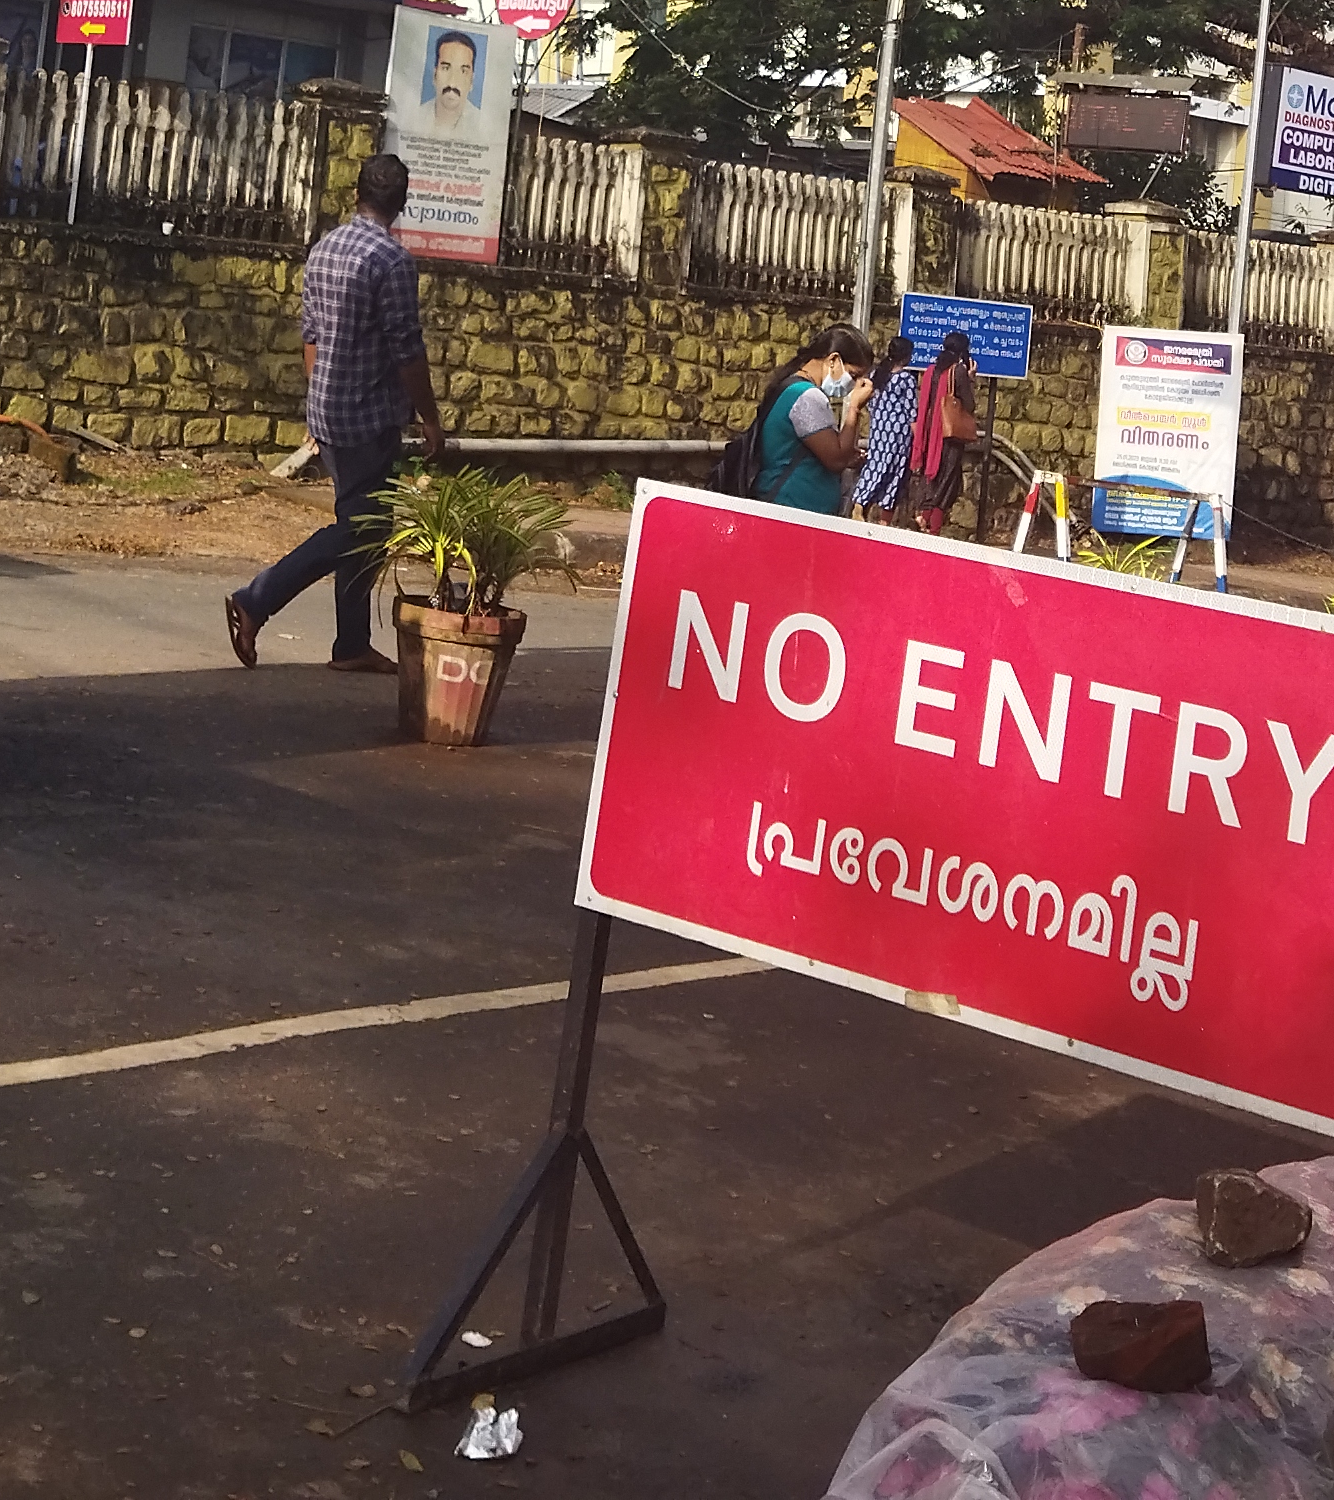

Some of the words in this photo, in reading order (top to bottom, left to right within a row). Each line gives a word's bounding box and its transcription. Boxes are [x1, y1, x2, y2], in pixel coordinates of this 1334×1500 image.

[1120, 425, 1210, 450] വിതരണം
[668, 589, 847, 723] NO
[746, 801, 1200, 1013] പ്രവേശനമില്ല
